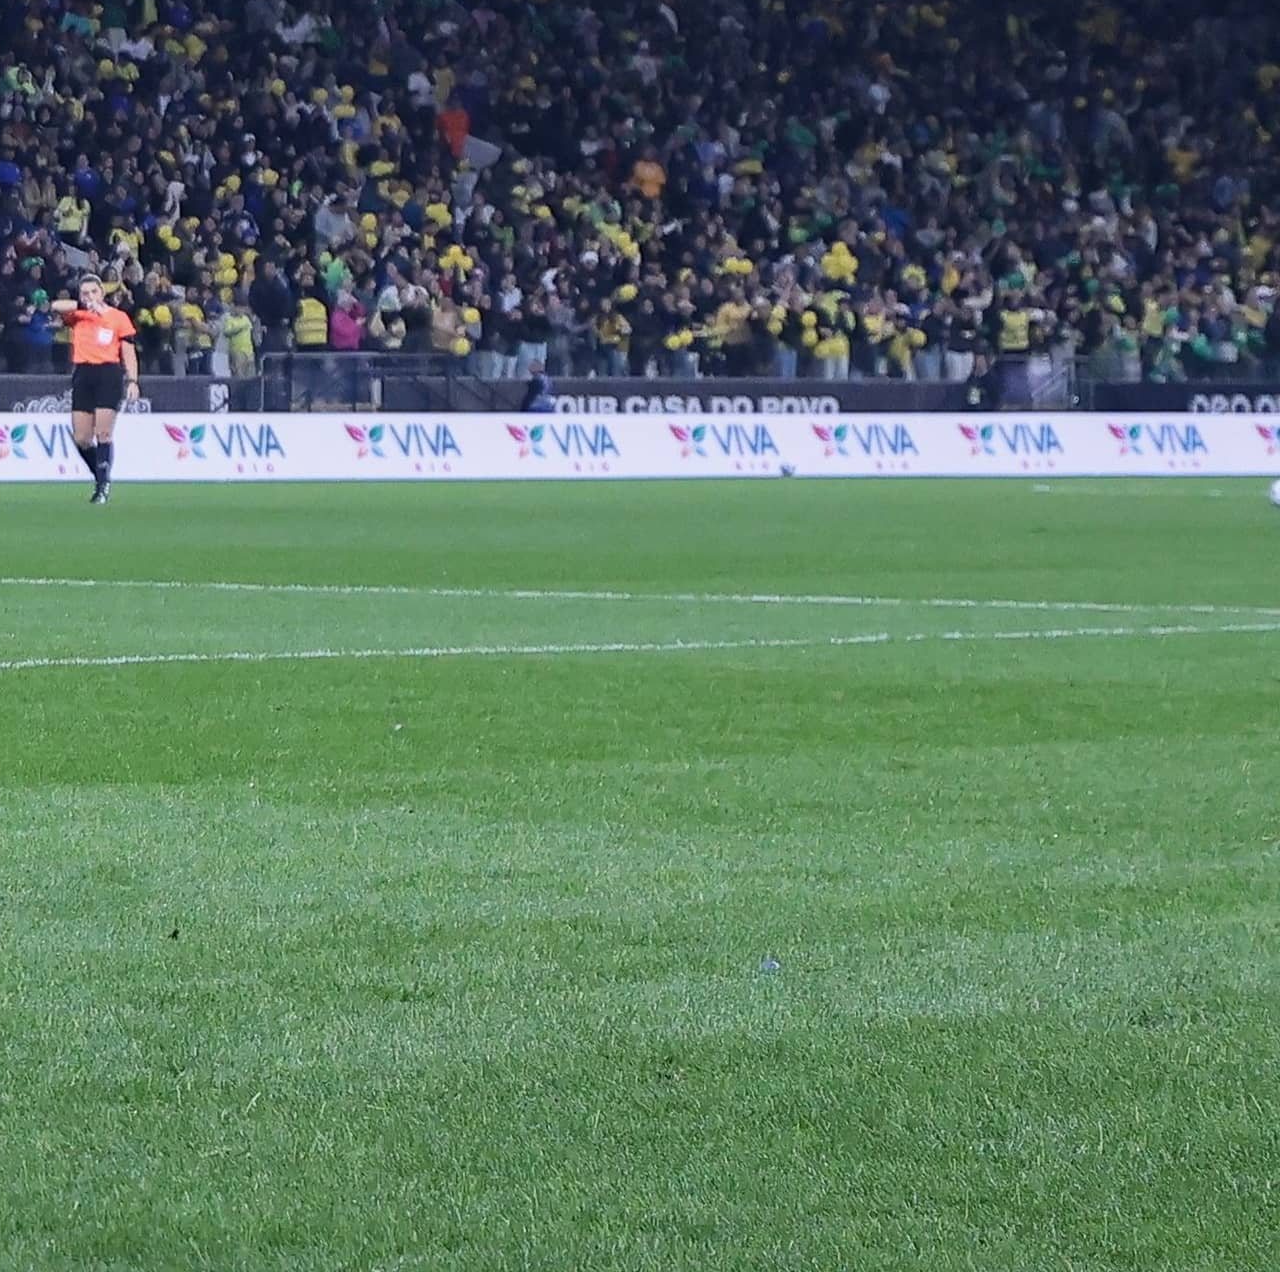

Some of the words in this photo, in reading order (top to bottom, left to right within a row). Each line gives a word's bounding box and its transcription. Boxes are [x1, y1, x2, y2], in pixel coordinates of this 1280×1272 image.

[33, 423, 80, 458] VI
[211, 423, 287, 458] VIVA
[390, 424, 462, 457] VIVA
[549, 424, 621, 456] VIVA
[710, 424, 780, 456] VIVA
[852, 424, 920, 455] VIVA
[998, 424, 1065, 454] VIVA
[1145, 424, 1210, 454] VIVA
